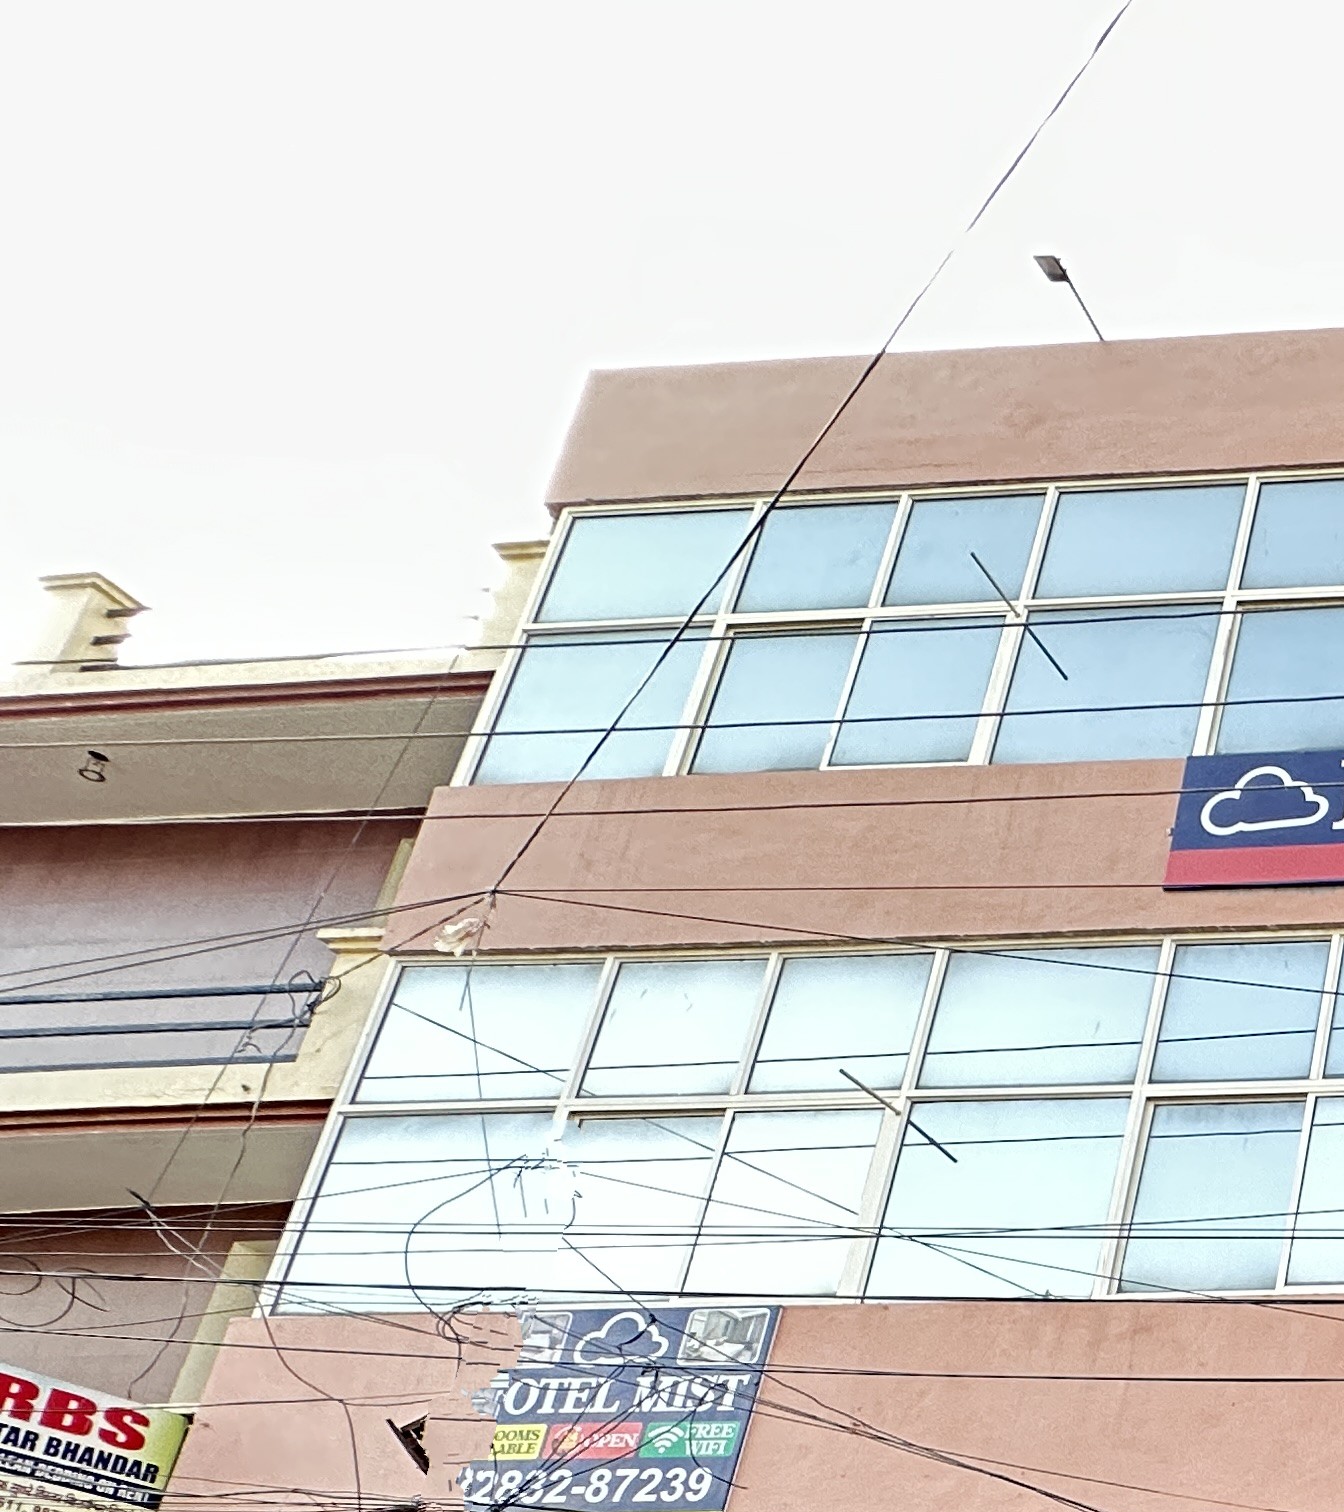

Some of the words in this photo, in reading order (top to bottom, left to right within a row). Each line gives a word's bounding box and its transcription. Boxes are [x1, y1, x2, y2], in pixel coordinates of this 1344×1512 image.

[0, 1373, 151, 1451] RBS
[633, 1374, 751, 1414] MIST
[684, 1439, 727, 1456] WIFI
[685, 1423, 734, 1438] FREE
[43, 1436, 159, 1484] BHANDAR
